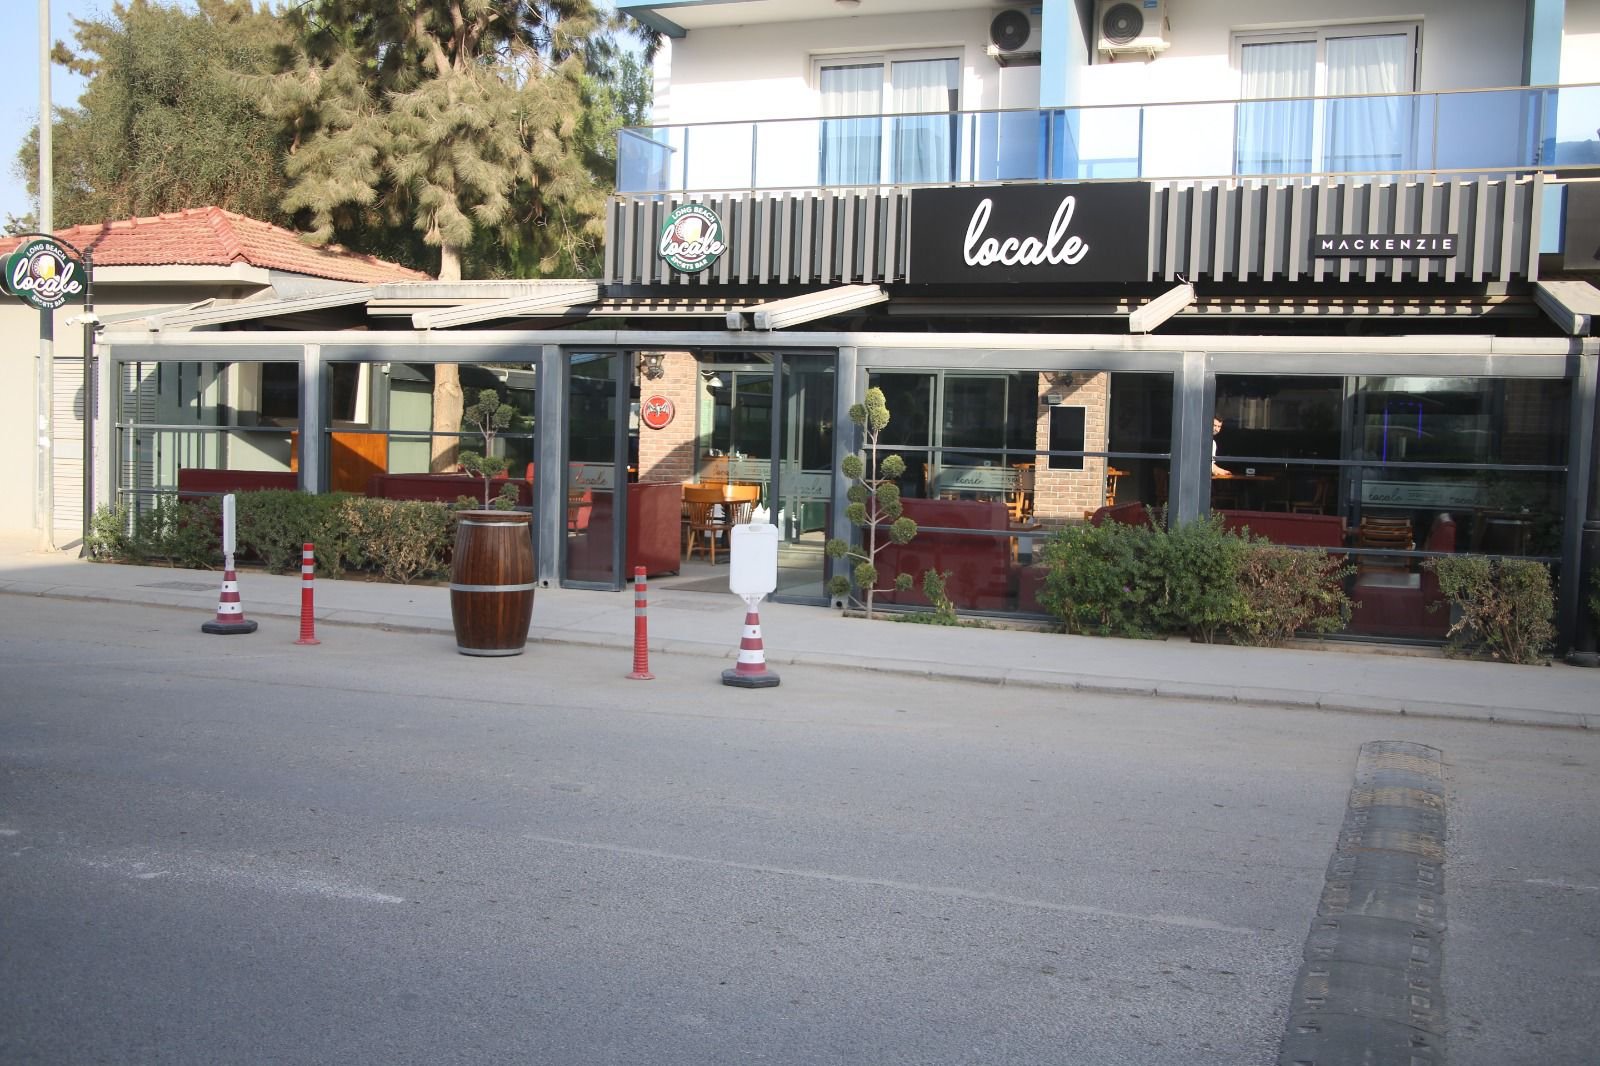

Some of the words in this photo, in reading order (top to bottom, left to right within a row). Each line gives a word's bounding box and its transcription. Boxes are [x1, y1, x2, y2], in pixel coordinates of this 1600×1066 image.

[672, 207, 692, 219] LONG
[694, 207, 716, 222] BEACH
[660, 222, 725, 256] locale
[964, 195, 1089, 267] locale
[27, 243, 44, 257] LONG
[45, 243, 66, 260] BEACH
[1321, 238, 1452, 251] MACKENZIE
[671, 256, 693, 269] SPORTS
[695, 260, 708, 269] BAR
[13, 257, 83, 294] locale
[31, 294, 54, 308] SPORTS
[55, 297, 66, 307] BAR
